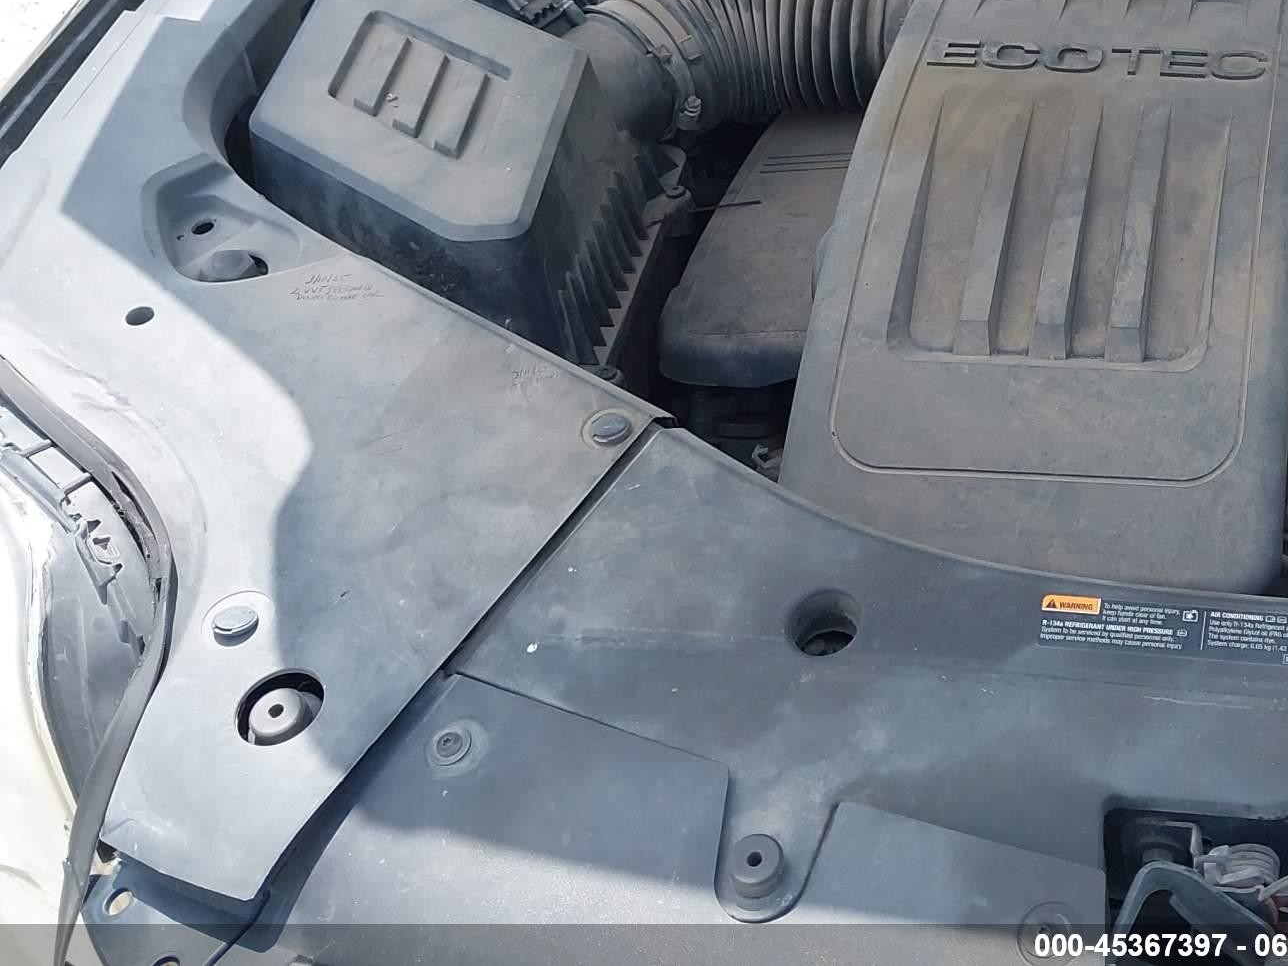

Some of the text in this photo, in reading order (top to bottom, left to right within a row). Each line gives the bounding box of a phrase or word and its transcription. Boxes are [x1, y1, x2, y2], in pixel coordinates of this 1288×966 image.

[926, 42, 1268, 81] ECOTEC
[1059, 601, 1093, 611] WARNING
[1222, 612, 1265, 621] CONDITIONING
[1065, 621, 1105, 630] REFRIGERANT
[1106, 624, 1127, 632] UNDER
[1143, 627, 1173, 635] PRESSURE
